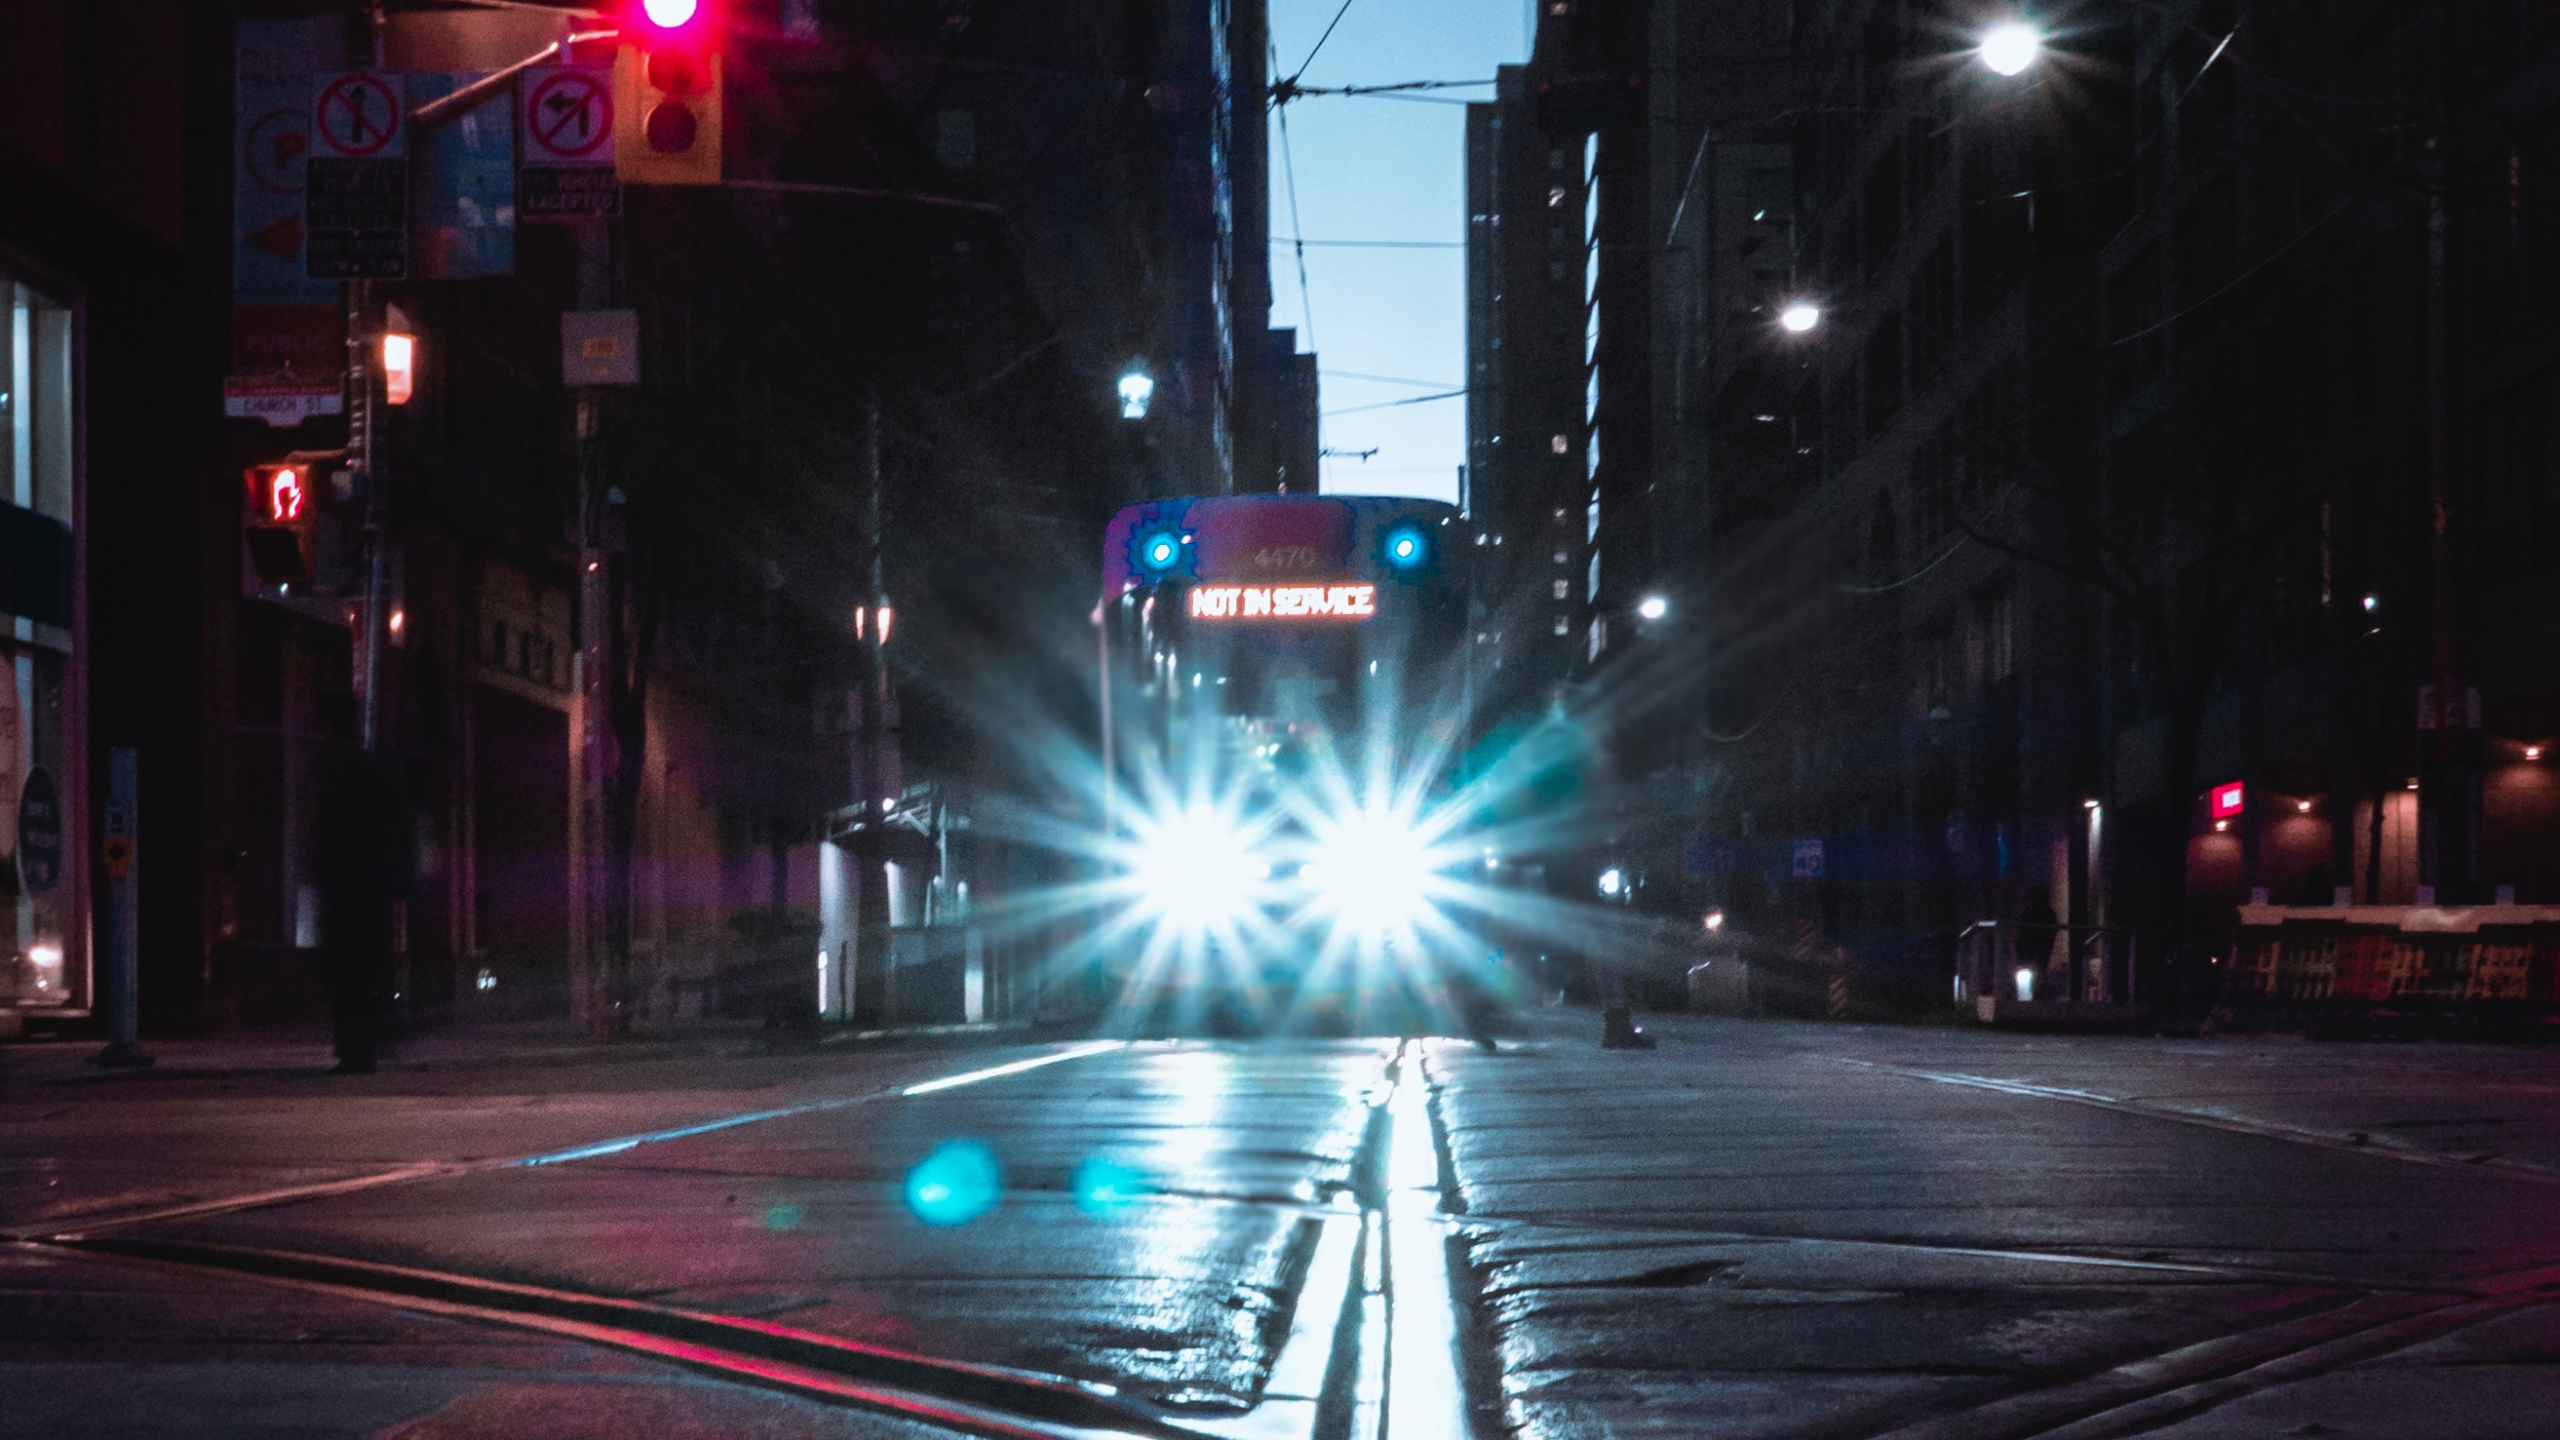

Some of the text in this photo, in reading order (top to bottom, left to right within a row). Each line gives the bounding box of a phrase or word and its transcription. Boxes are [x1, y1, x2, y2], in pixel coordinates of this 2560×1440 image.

[275, 132, 306, 170] P
[528, 193, 614, 209] EXCEPTED
[244, 396, 321, 412] CHURCH ST
[1254, 545, 1316, 568] 4470
[1191, 585, 1375, 617] NOT IN SERVICE
